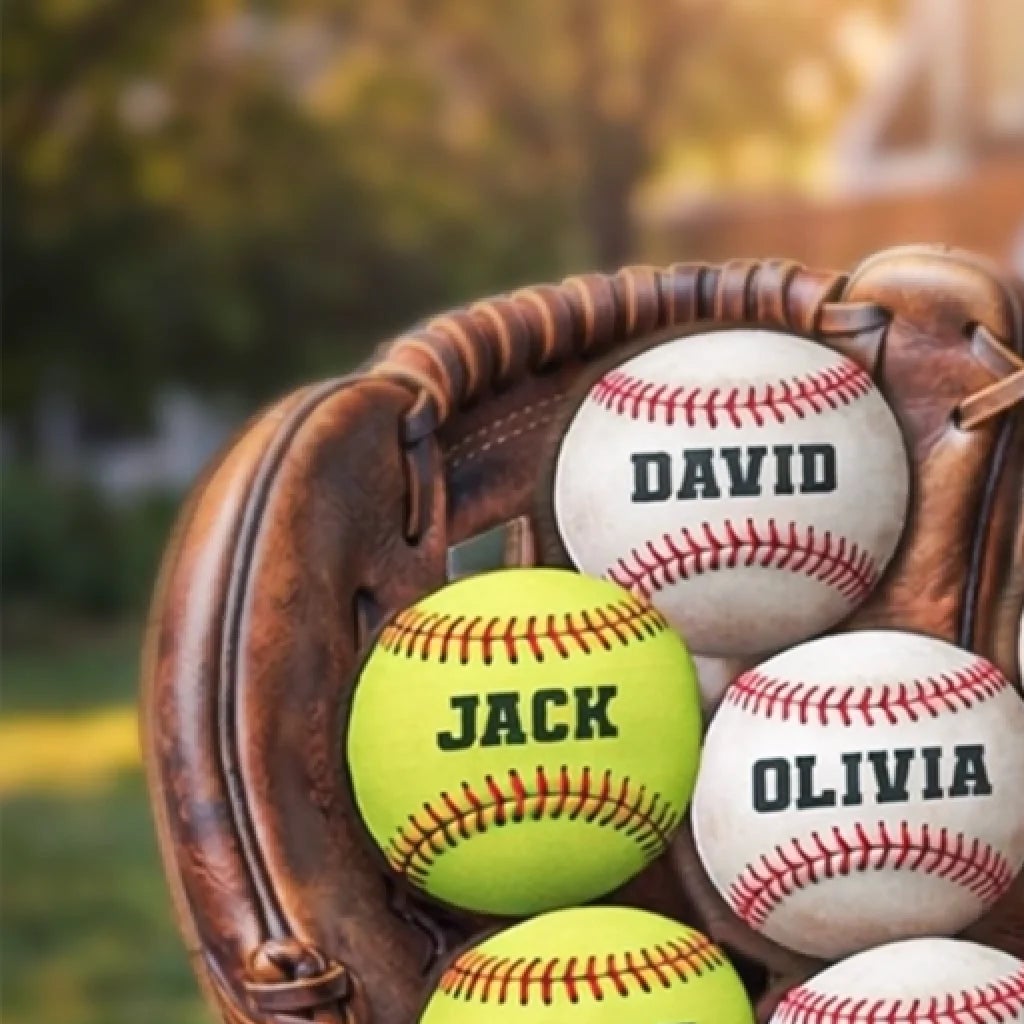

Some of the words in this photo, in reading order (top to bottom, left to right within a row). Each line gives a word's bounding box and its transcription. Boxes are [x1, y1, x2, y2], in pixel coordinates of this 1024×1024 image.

[630, 442, 838, 504] DAVID
[436, 684, 619, 752] JACK
[751, 743, 994, 814] OLIVIA
